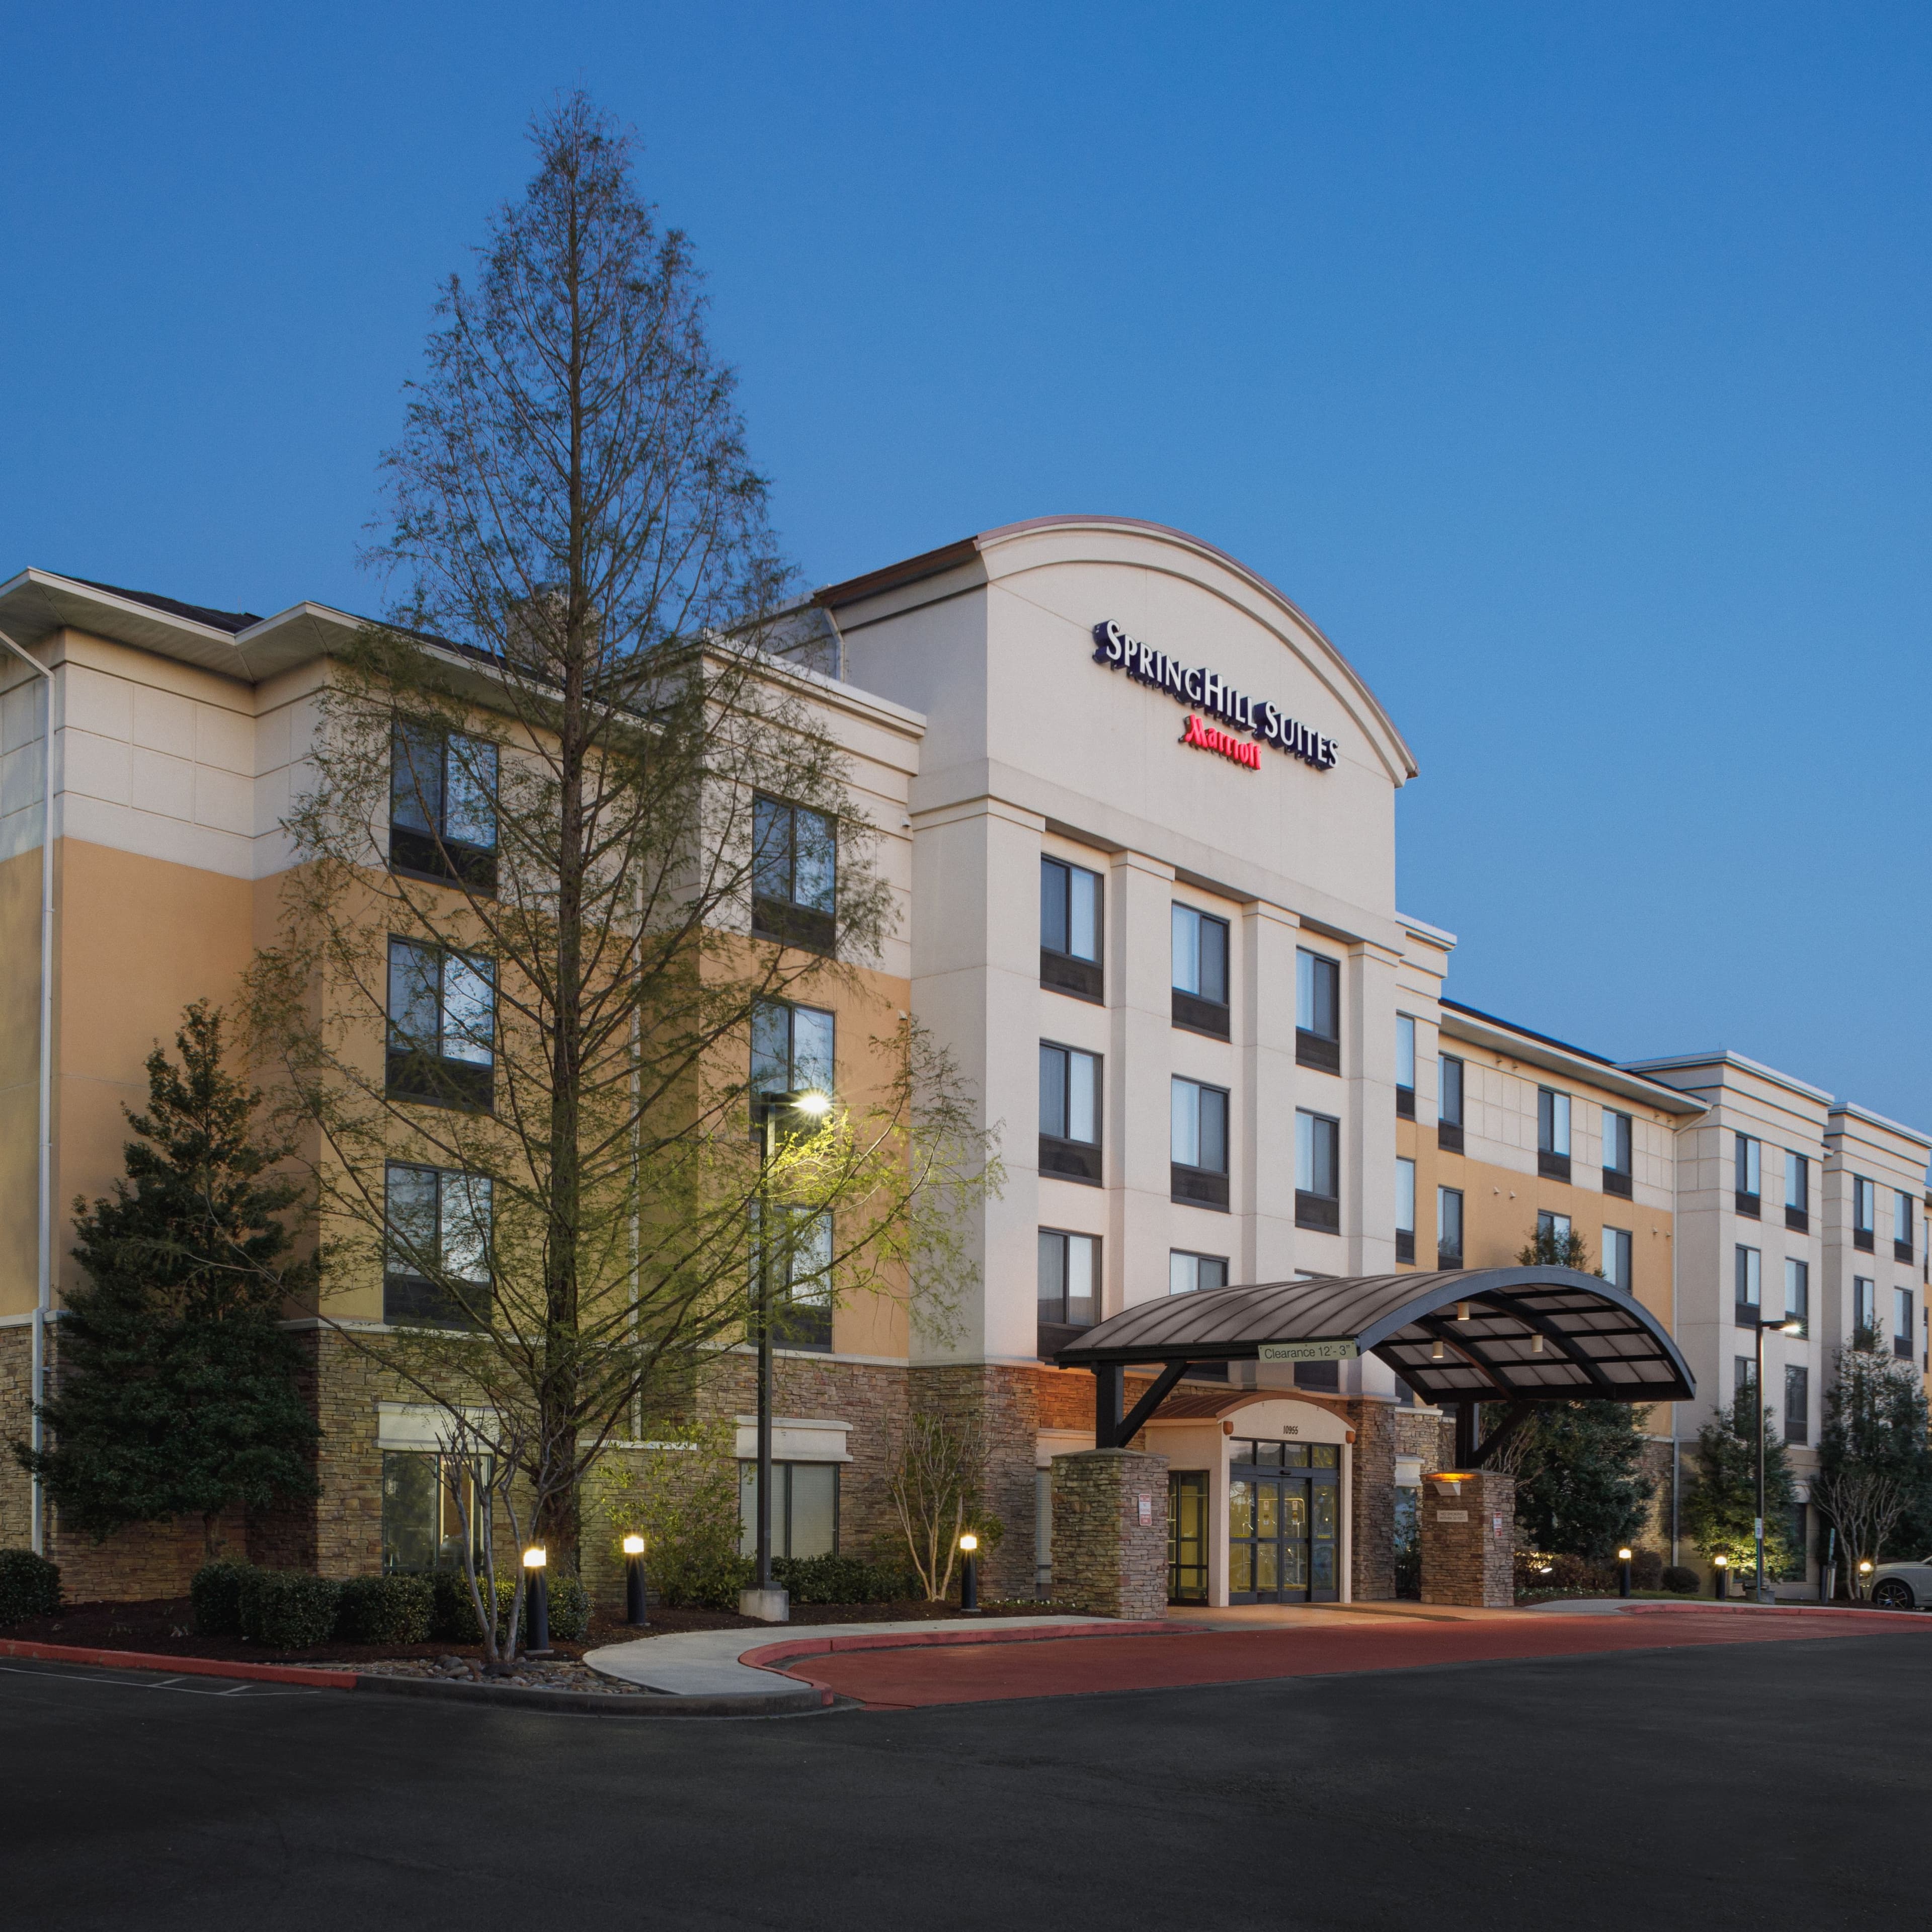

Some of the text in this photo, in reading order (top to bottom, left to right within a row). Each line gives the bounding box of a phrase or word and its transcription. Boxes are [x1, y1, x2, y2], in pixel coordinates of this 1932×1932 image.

[1184, 713, 1262, 770] Marriott
[1264, 700, 1339, 769] SUITES
[1264, 1348, 1315, 1359] Clearance
[1283, 1425, 1299, 1434] 10955
